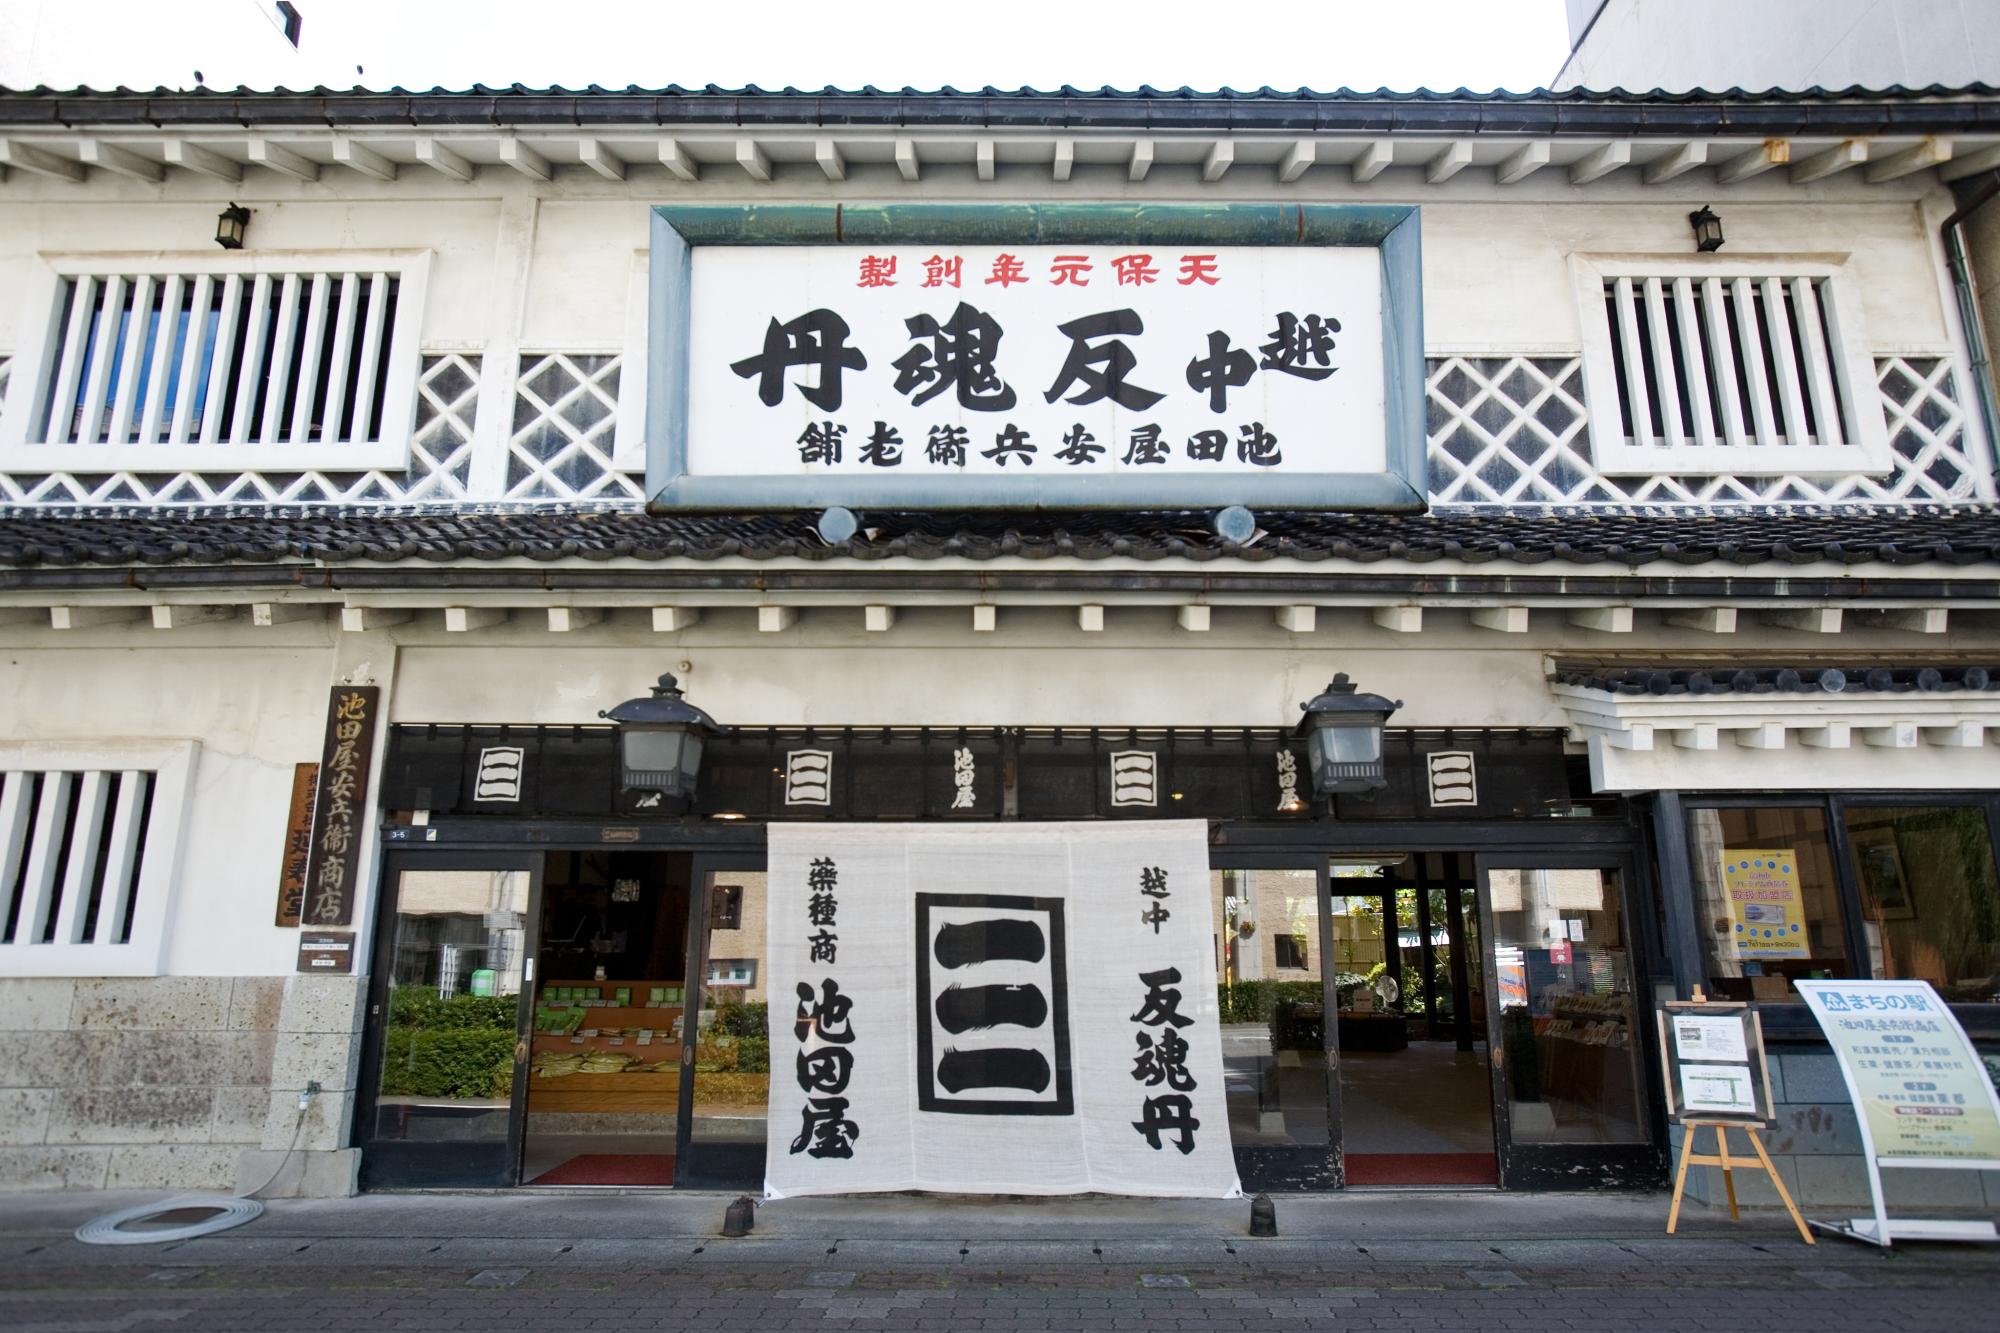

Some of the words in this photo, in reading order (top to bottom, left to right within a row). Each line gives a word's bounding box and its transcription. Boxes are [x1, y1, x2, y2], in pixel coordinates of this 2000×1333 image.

[951, 747, 977, 809] 池田屋
[1276, 749, 1300, 811] 池田屋
[391, 831, 406, 839] 3-5
[1140, 866, 1171, 935] 越中
[1846, 994, 1933, 1012] まちの駅
[789, 977, 860, 1160] 池田屋
[1129, 966, 1201, 1156] 反魂丹
